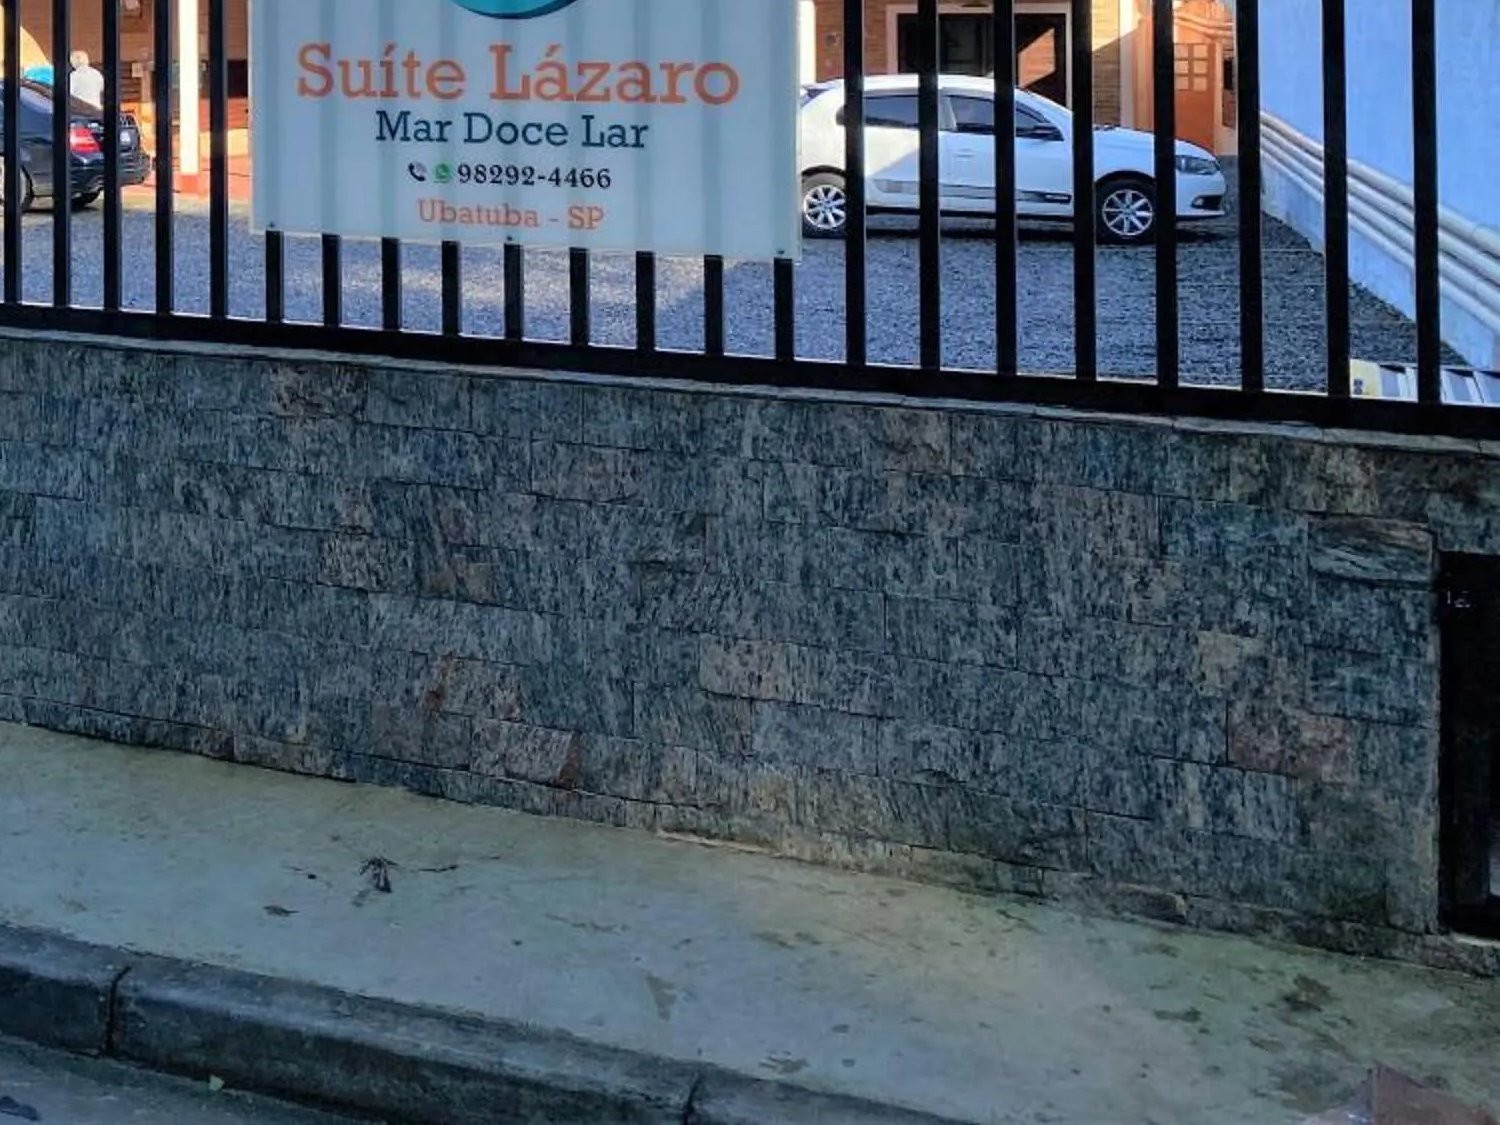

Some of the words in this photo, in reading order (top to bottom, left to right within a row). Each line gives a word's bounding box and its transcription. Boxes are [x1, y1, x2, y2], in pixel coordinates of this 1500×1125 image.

[296, 41, 467, 100] Suíte
[488, 42, 740, 105] Lázaro
[375, 109, 453, 143] Mar
[462, 111, 569, 146] Doce
[581, 114, 650, 148] Lar
[456, 163, 612, 189] 98292-4466
[417, 198, 539, 228] Ubatuba
[567, 205, 605, 230] SP
